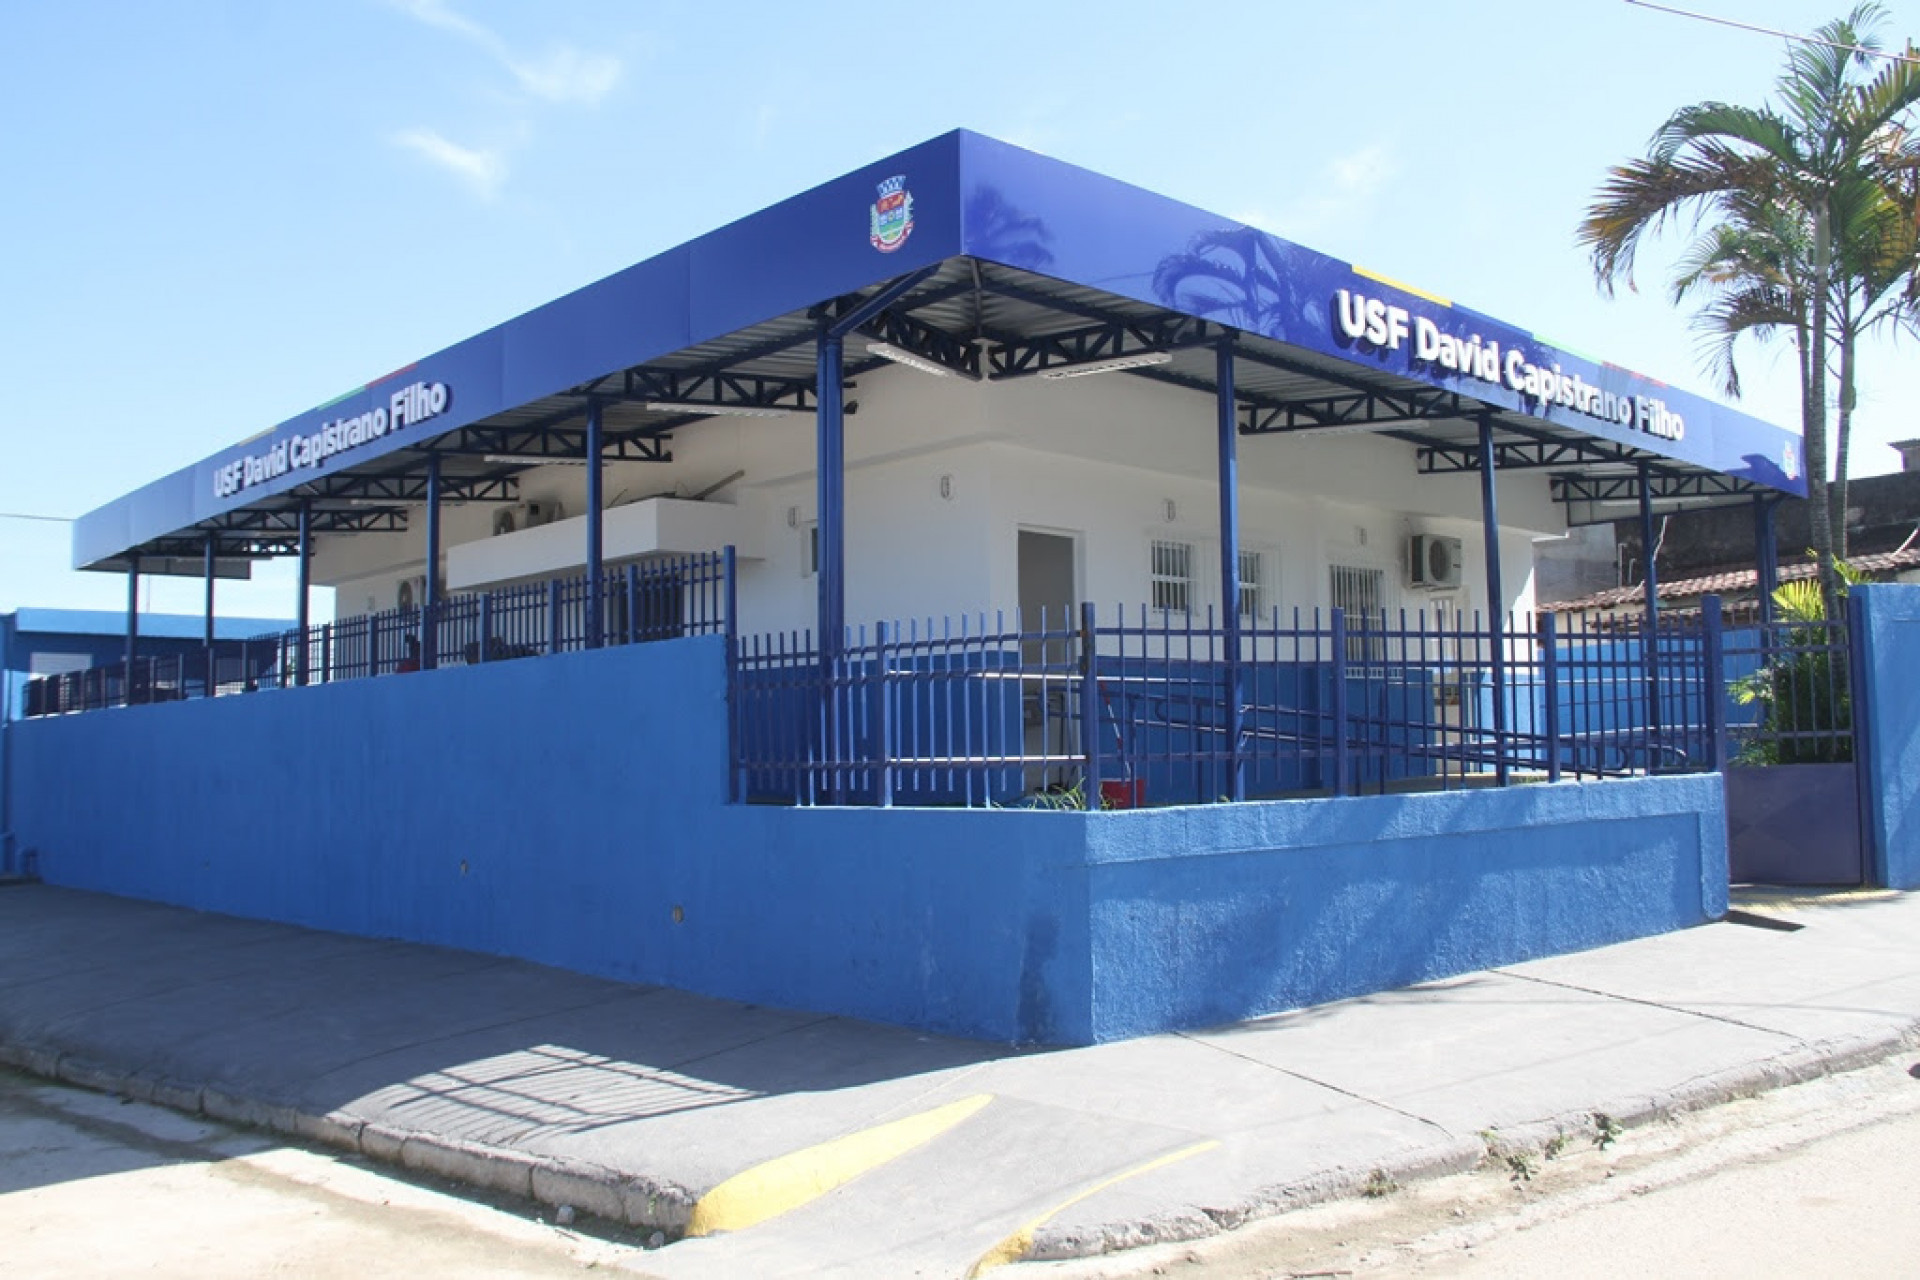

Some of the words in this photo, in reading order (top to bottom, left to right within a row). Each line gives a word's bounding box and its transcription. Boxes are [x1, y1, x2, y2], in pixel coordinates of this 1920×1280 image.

[1336, 289, 1409, 349] USF
[1414, 316, 1500, 383] David
[1505, 349, 1632, 424] Capistrano
[1635, 394, 1685, 441] Filho
[214, 459, 243, 497] USF
[243, 439, 288, 485] David
[290, 407, 388, 468] Capistrano
[390, 381, 447, 430] Filho
